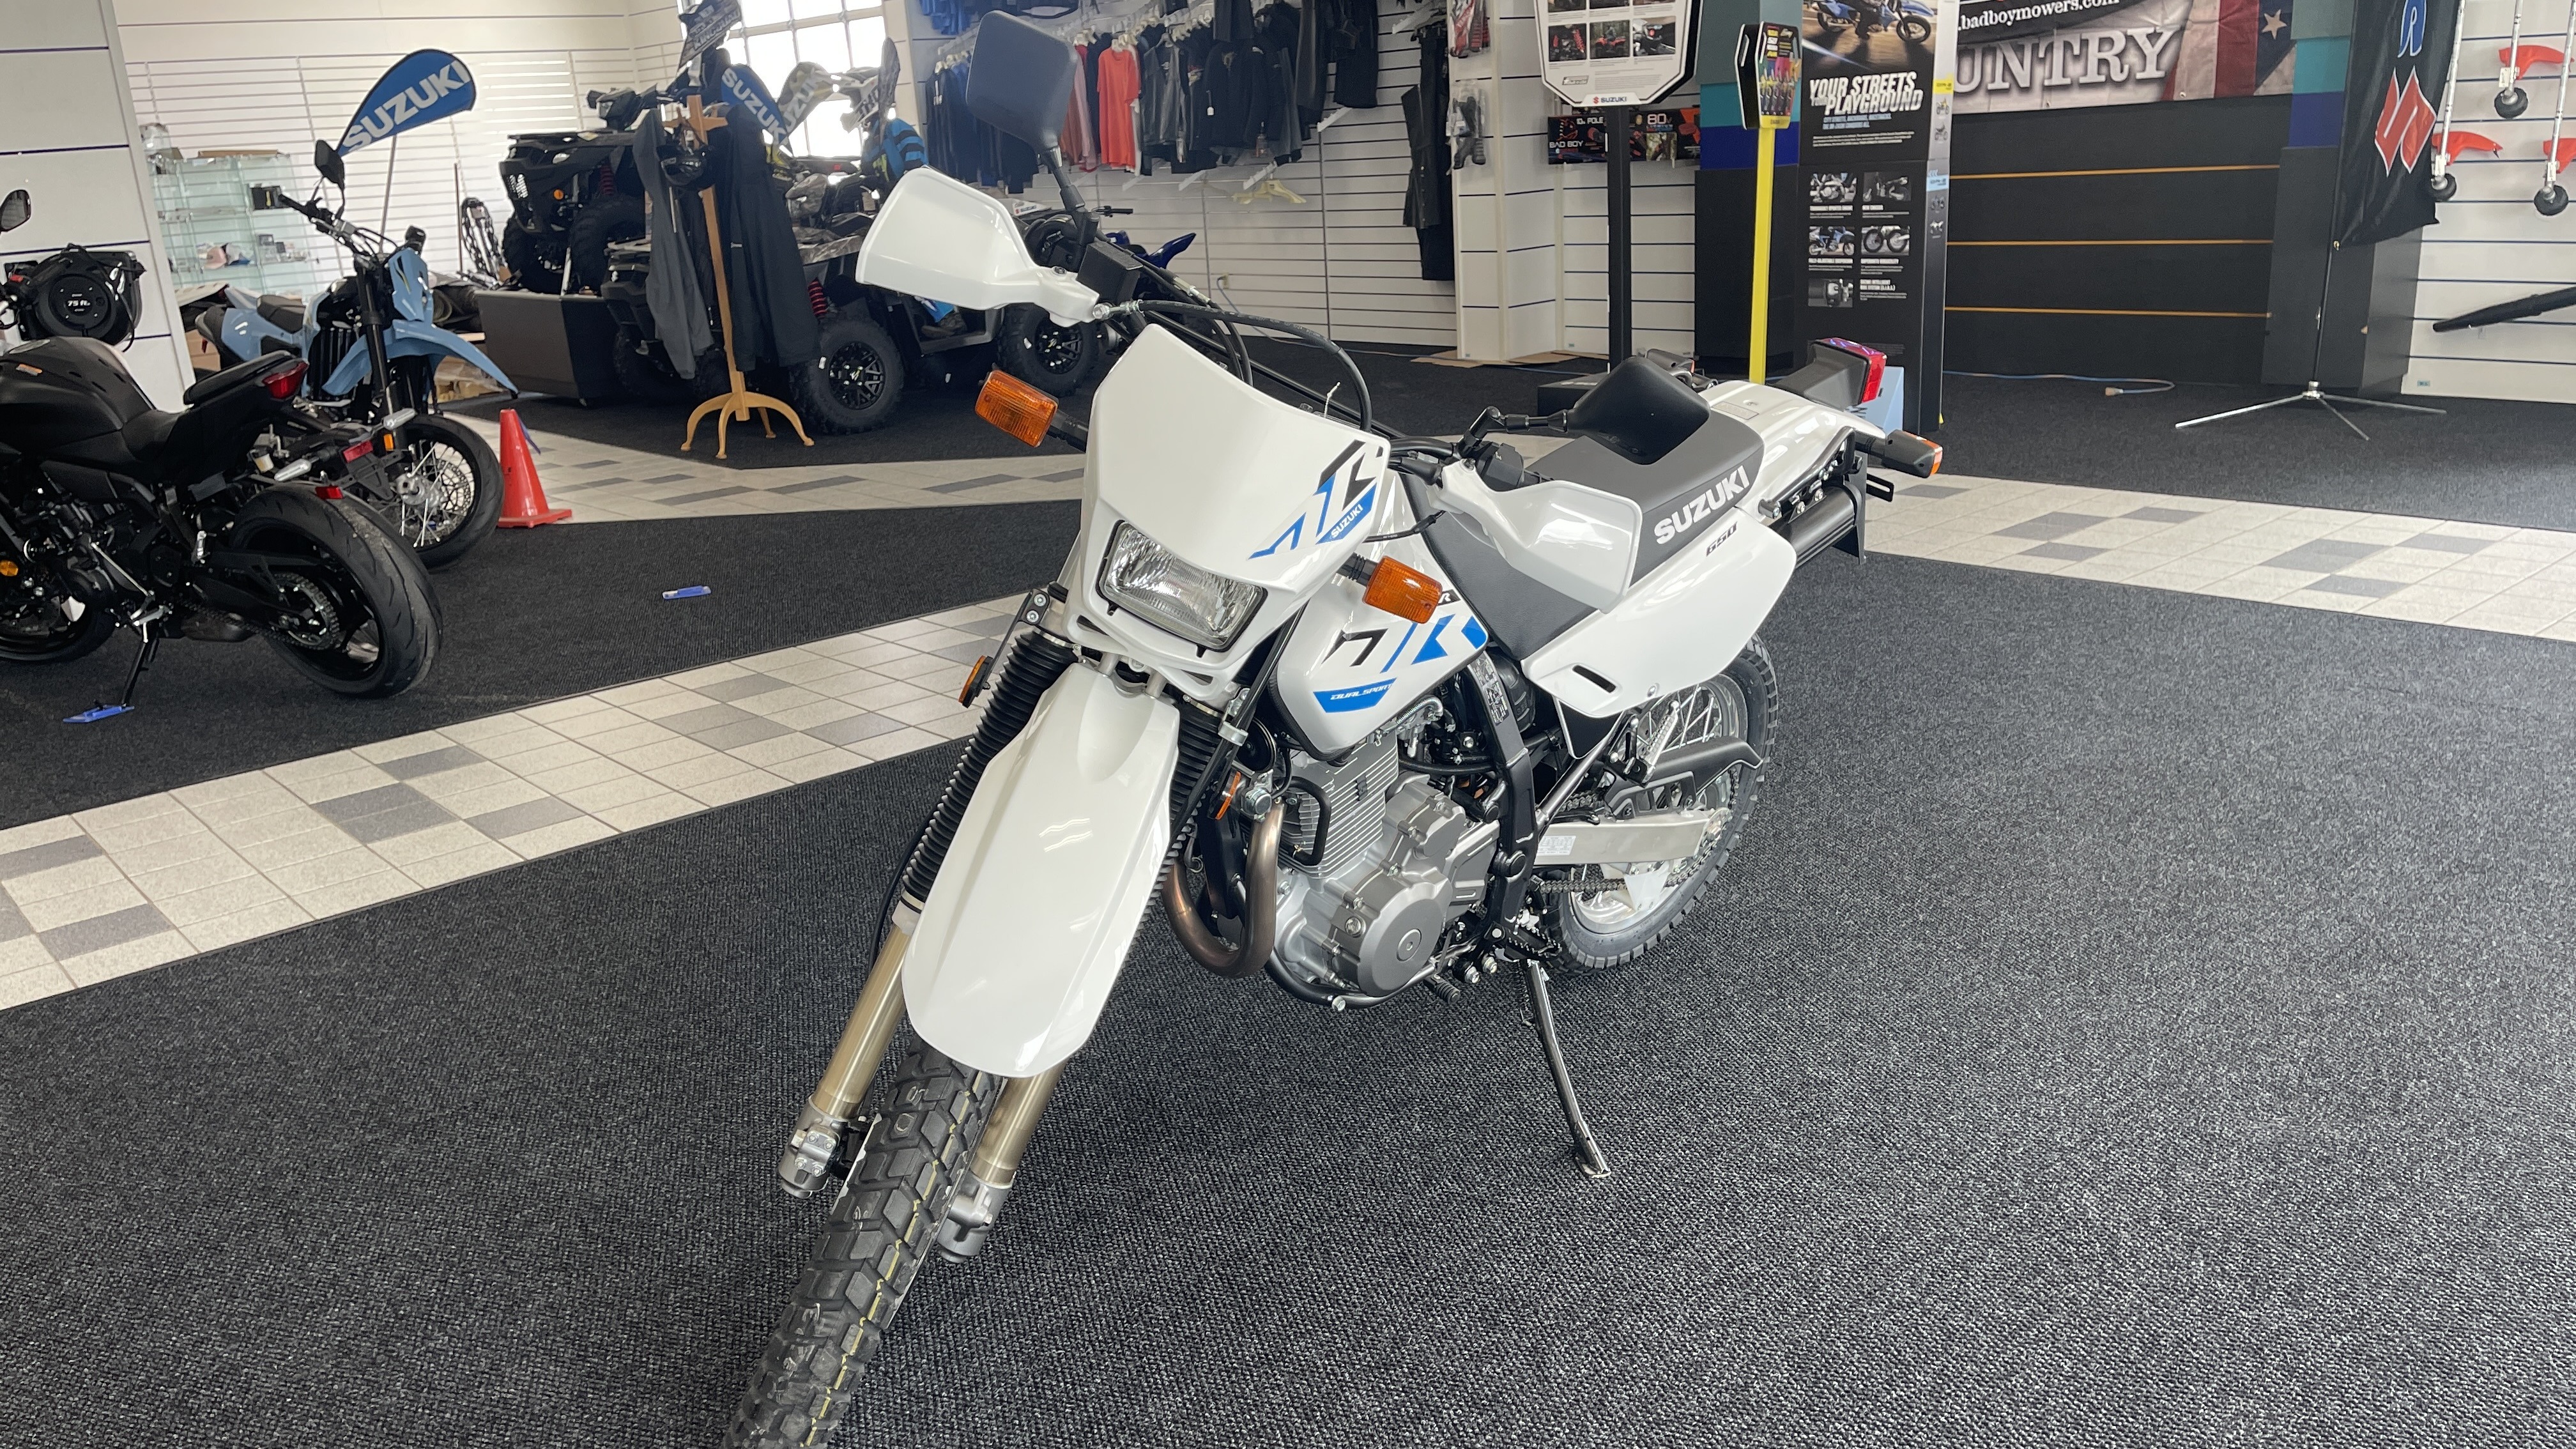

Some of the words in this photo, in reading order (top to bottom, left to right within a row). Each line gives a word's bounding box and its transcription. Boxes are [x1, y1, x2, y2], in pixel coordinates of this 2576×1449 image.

[1809, 77, 1849, 98] YOUR
[1850, 71, 1917, 96] STREETS
[1825, 89, 1924, 115] PLAYGROUND
[342, 60, 471, 151] SUZUKI
[721, 67, 786, 145] SUZUK
[1331, 503, 1363, 539] SUZUKI
[1653, 465, 1750, 544] SUZUKI
[1706, 521, 1738, 557] 650
[1330, 691, 1361, 700] DUAL
[1362, 684, 1393, 696] SPORT
